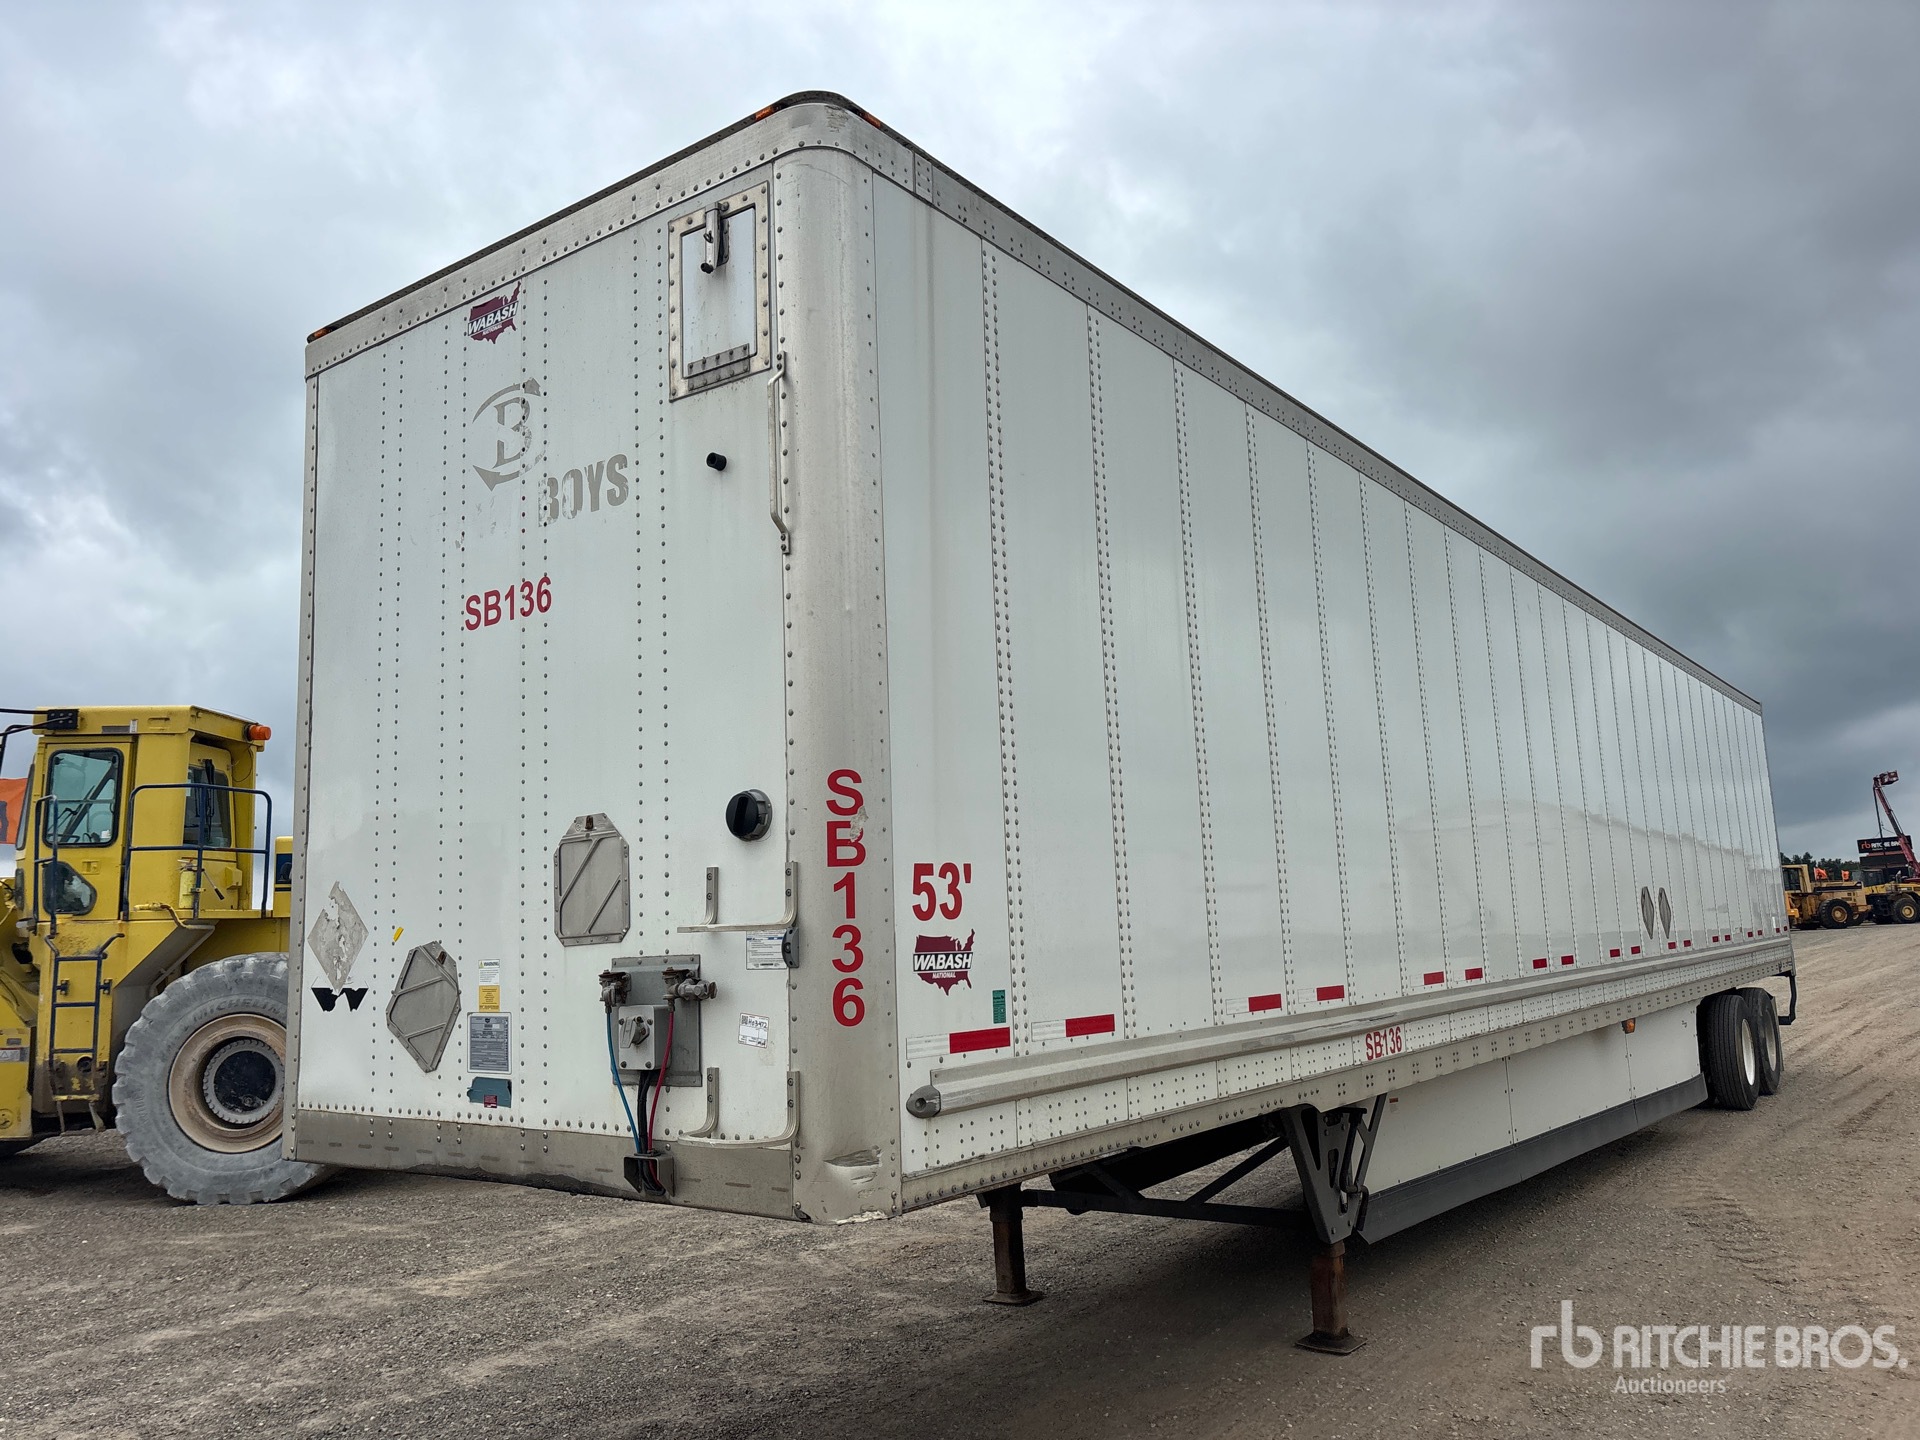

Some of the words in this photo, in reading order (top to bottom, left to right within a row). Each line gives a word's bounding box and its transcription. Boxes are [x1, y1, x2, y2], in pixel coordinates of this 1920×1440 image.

[468, 302, 518, 336] WABASH
[538, 454, 629, 527] BOYS
[465, 576, 552, 631] SB136
[826, 768, 867, 1027] SB136
[912, 862, 972, 921] 53'
[913, 953, 973, 971] WABASH
[1366, 1026, 1402, 1060] SB136
